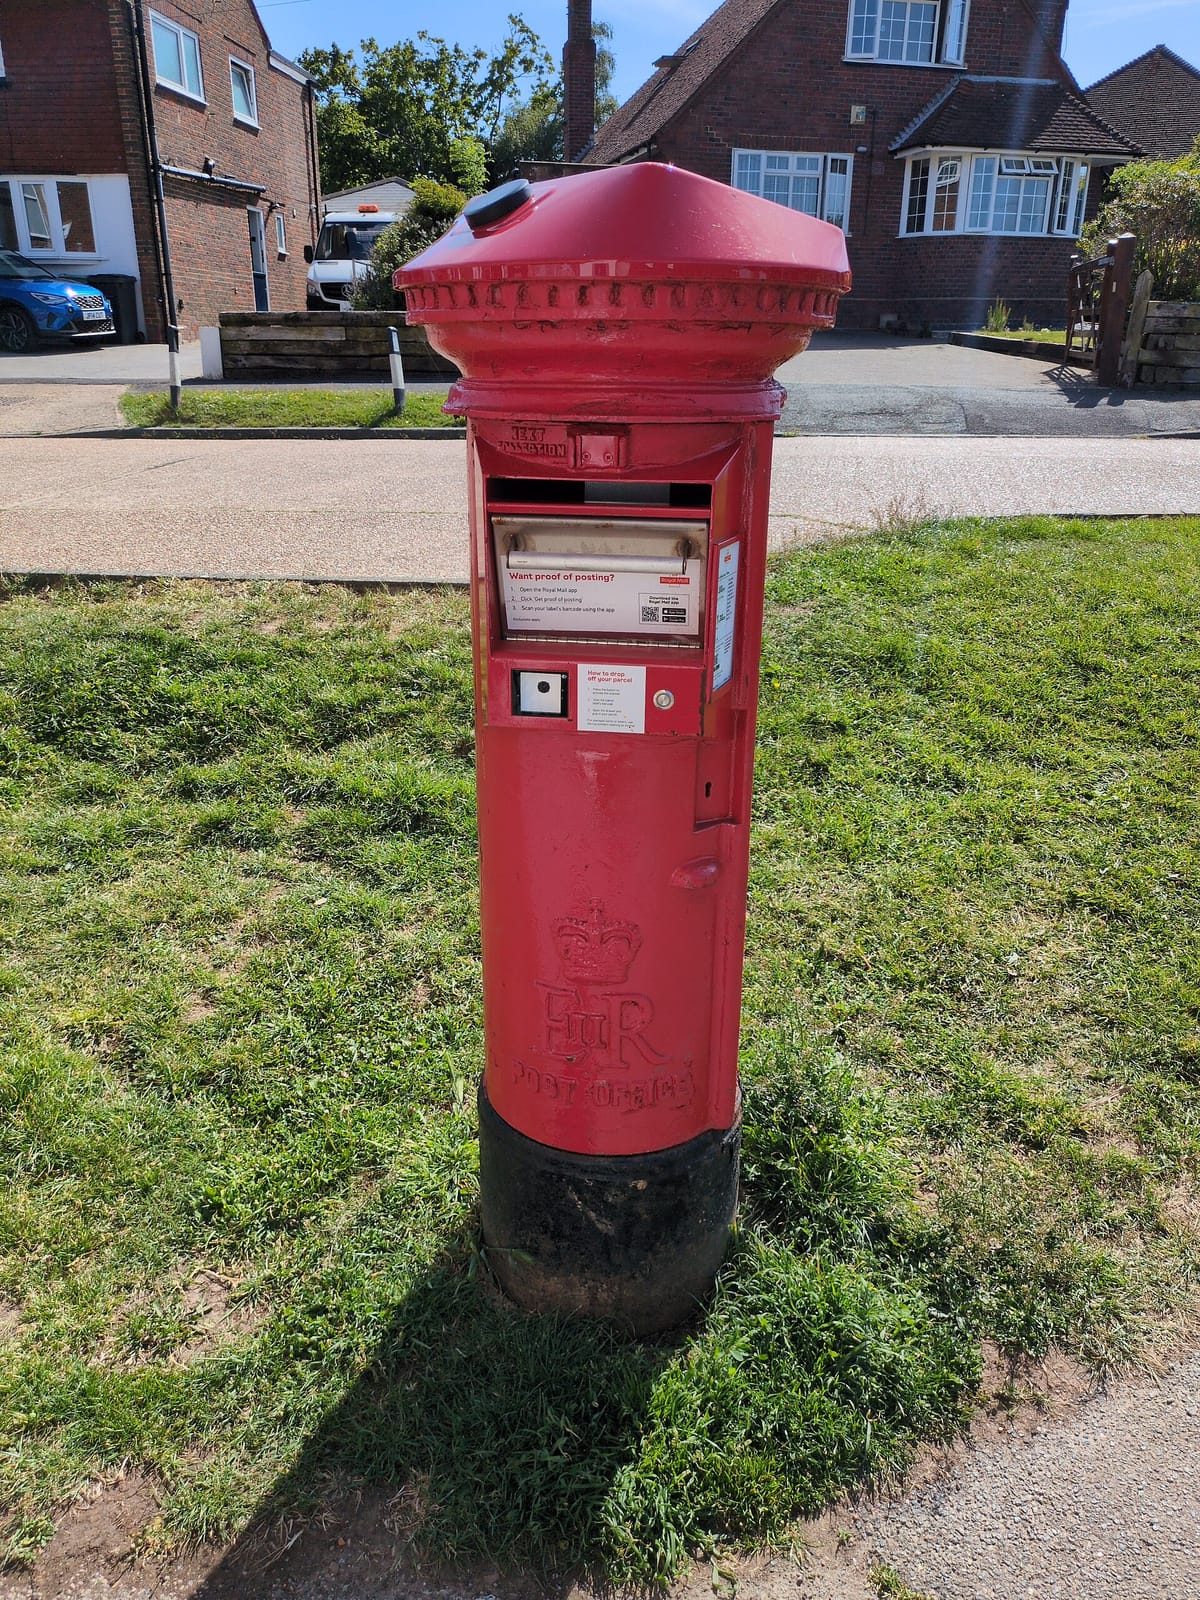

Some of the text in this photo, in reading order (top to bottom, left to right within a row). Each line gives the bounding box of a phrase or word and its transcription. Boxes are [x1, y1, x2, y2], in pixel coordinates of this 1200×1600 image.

[509, 572, 533, 580] Want
[535, 573, 560, 582] proof
[575, 574, 615, 582] posting?
